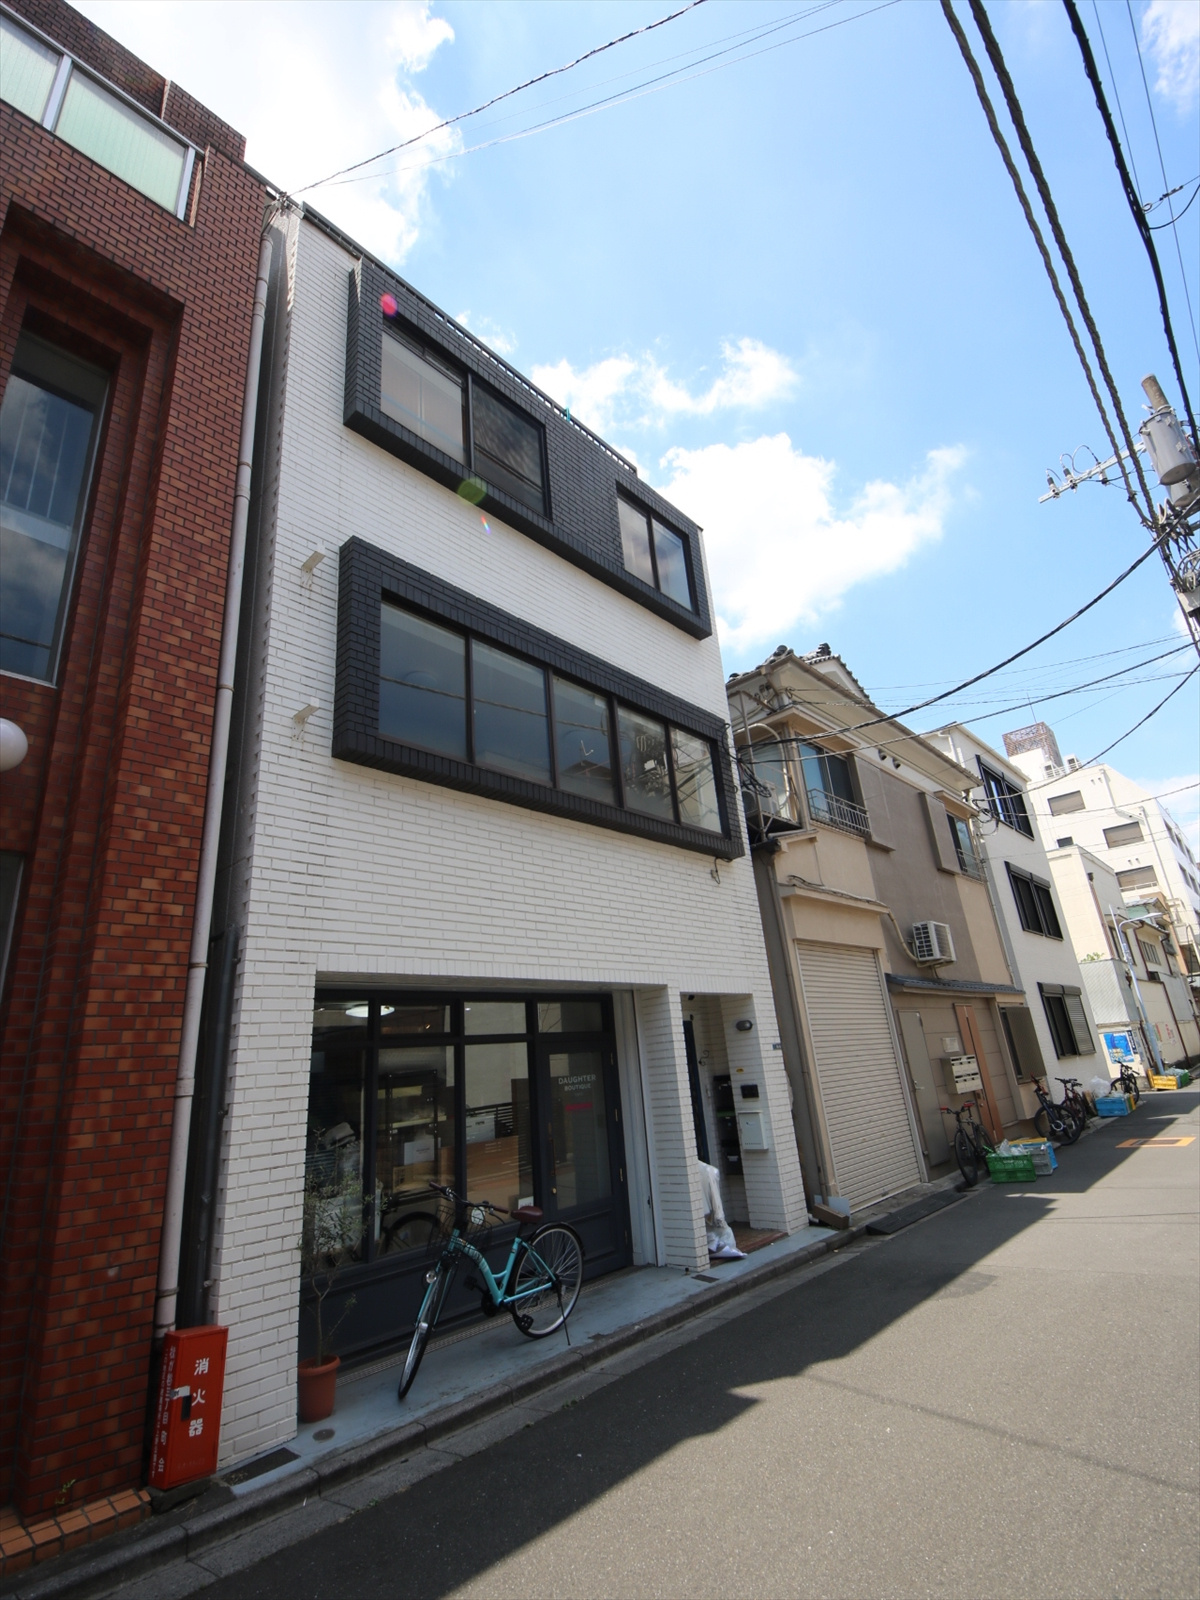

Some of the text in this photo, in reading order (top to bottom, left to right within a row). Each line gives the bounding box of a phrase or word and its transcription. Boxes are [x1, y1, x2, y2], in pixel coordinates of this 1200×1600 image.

[558, 1074, 596, 1085] DAUGHTER
[189, 1357, 210, 1437] 消火器
